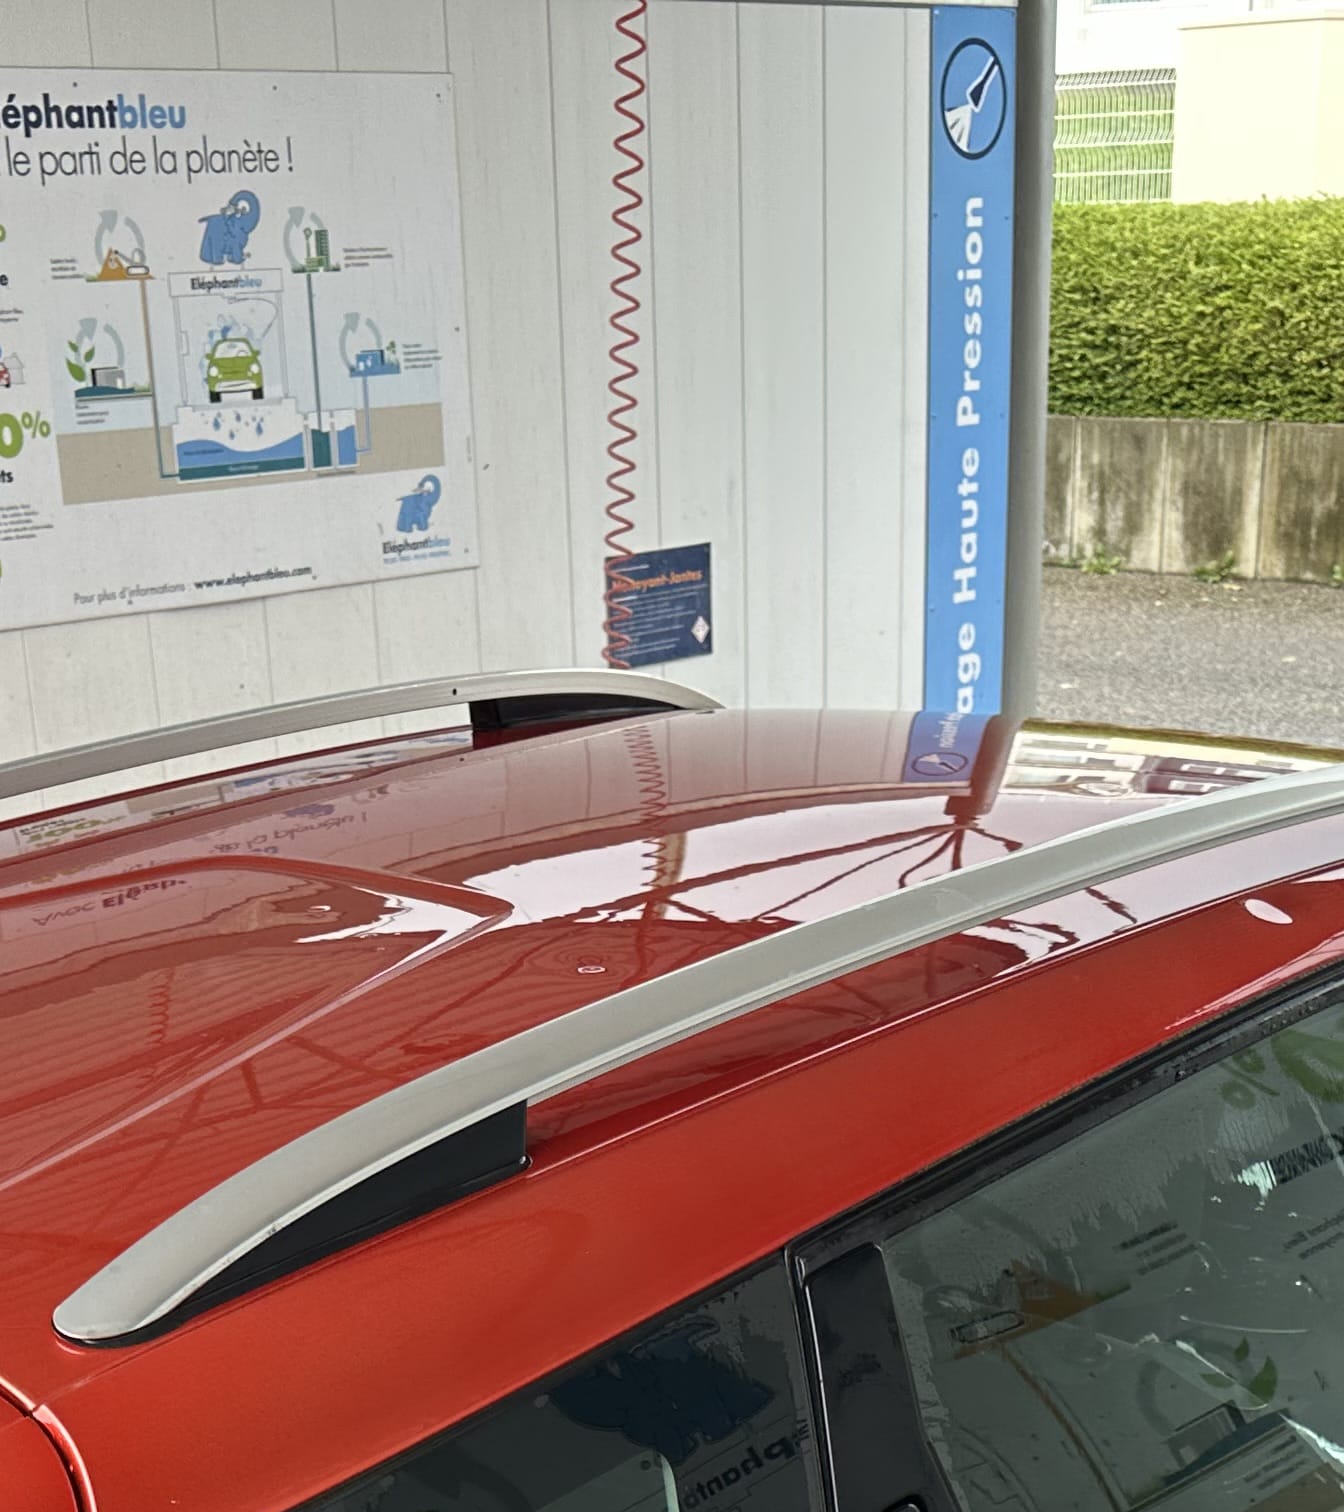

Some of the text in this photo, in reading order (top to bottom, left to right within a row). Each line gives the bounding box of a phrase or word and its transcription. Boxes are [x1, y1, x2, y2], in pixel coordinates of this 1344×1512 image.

[5, 135, 31, 177] le
[39, 142, 101, 186] parti
[109, 135, 147, 174] de
[152, 135, 177, 174] la
[185, 134, 280, 184] planète
[286, 136, 294, 172] !
[958, 196, 984, 427] Pression
[953, 446, 980, 604] Haute
[957, 621, 982, 714] age
